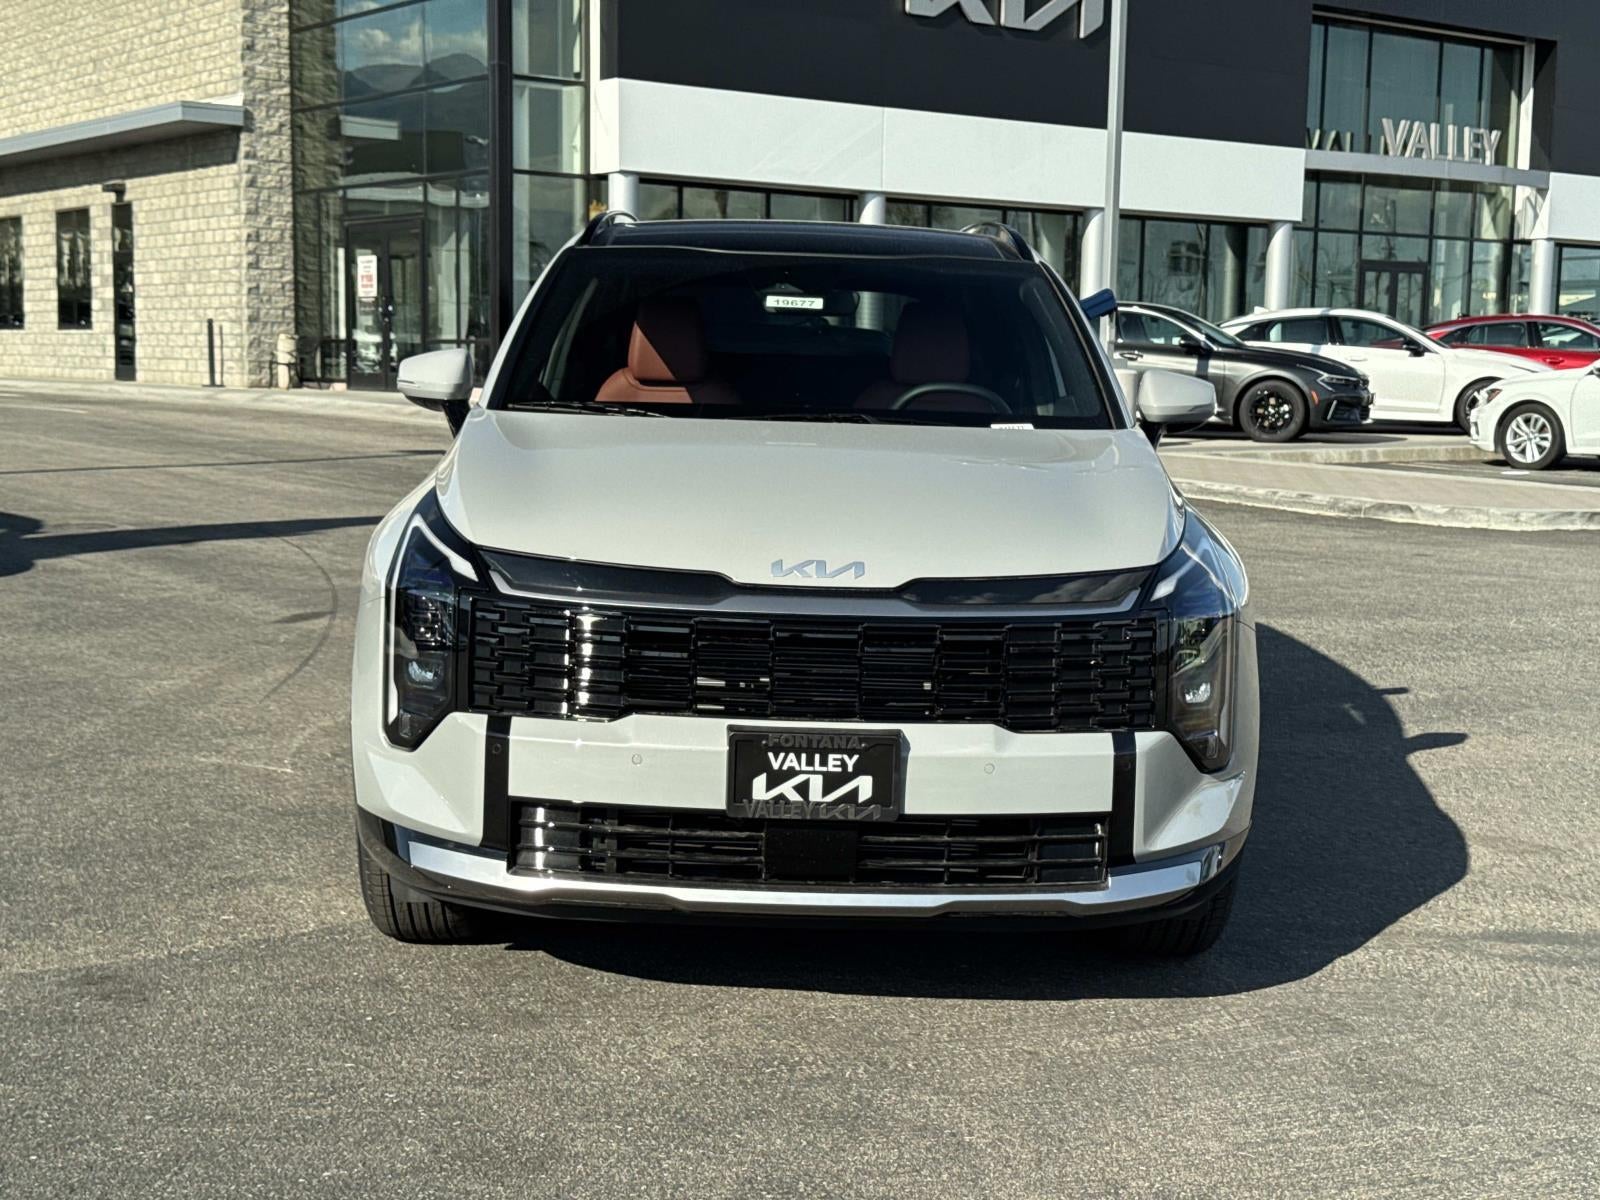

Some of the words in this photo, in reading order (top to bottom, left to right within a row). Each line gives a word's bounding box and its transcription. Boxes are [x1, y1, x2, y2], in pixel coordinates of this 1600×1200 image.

[1381, 117, 1501, 166] VALLEY
[773, 298, 816, 307] 19677
[770, 559, 866, 580] KIA
[767, 733, 862, 750] FONTANA
[767, 752, 860, 772] VALLEY
[752, 772, 873, 803] KIA
[743, 799, 817, 820] VALLEY
